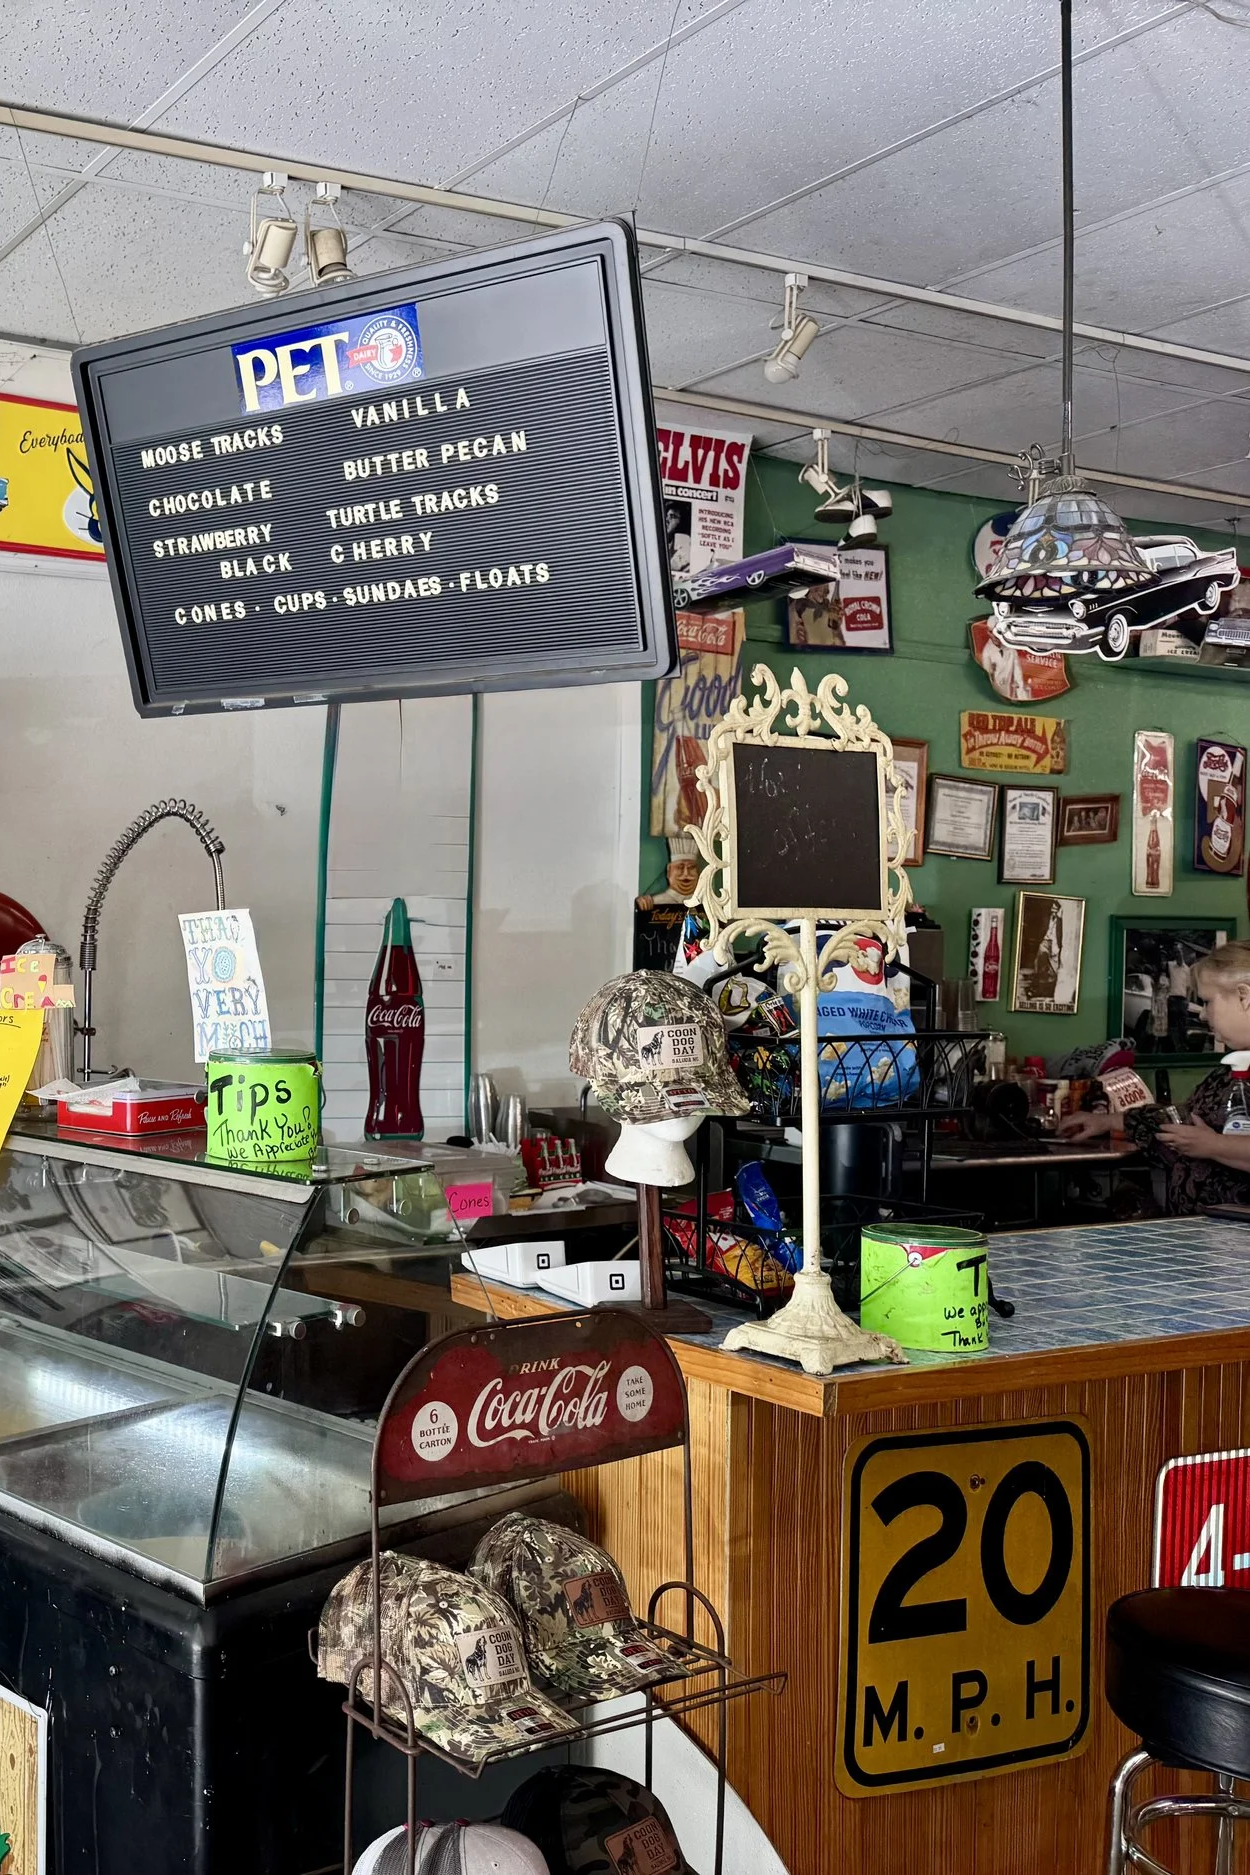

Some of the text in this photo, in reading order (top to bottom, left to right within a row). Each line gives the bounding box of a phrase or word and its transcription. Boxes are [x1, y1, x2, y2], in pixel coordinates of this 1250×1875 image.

[353, 347, 377, 362] DAIRY
[361, 319, 416, 371] QUALITY FRESHNESS
[236, 331, 349, 412] PET
[364, 362, 403, 382] SINCE 1929
[351, 387, 471, 428] VANILLA
[19, 427, 85, 454] Everybod
[140, 424, 284, 469] MOOSE TRACKS
[342, 431, 528, 481] BUTTER PECAN
[148, 479, 273, 518] CHOCOLATE
[677, 486, 717, 501] concert
[325, 483, 500, 529] TURTLE TRACKS
[698, 508, 734, 519] INTRODUCING
[153, 523, 273, 559] STRAWBERRY
[220, 552, 292, 580] BLACK
[174, 562, 551, 626] CONES CUPS SUNDAES FLOATS
[367, 1004, 423, 1028] Coca-Cola
[847, 1006, 880, 1022] WHITE
[667, 1027, 697, 1038] COON
[672, 1037, 695, 1047] DOG
[673, 1046, 696, 1056] DAY
[209, 1074, 292, 1125] Tips
[213, 1117, 272, 1148] Thank
[227, 1145, 248, 1160] We
[253, 1134, 310, 1161] Appreciate
[448, 1192, 491, 1213] Cones
[941, 1329, 984, 1348] Thank
[508, 1357, 562, 1376] DRINK
[626, 1376, 644, 1386] TAKE
[624, 1387, 646, 1399] SOME
[466, 1360, 612, 1448] Coca-Cola
[625, 1400, 646, 1411] HOME
[428, 1408, 439, 1424] 6
[419, 1423, 451, 1439] BOTTLE
[419, 1436, 452, 1450] CARTON
[868, 1460, 1074, 1645] 20
[488, 1629, 513, 1646] COON
[494, 1642, 513, 1656] DOG
[497, 1653, 516, 1667] DAY
[633, 1821, 659, 1841] COON
[641, 1833, 662, 1849] DOG
[646, 1842, 666, 1860] DAY
